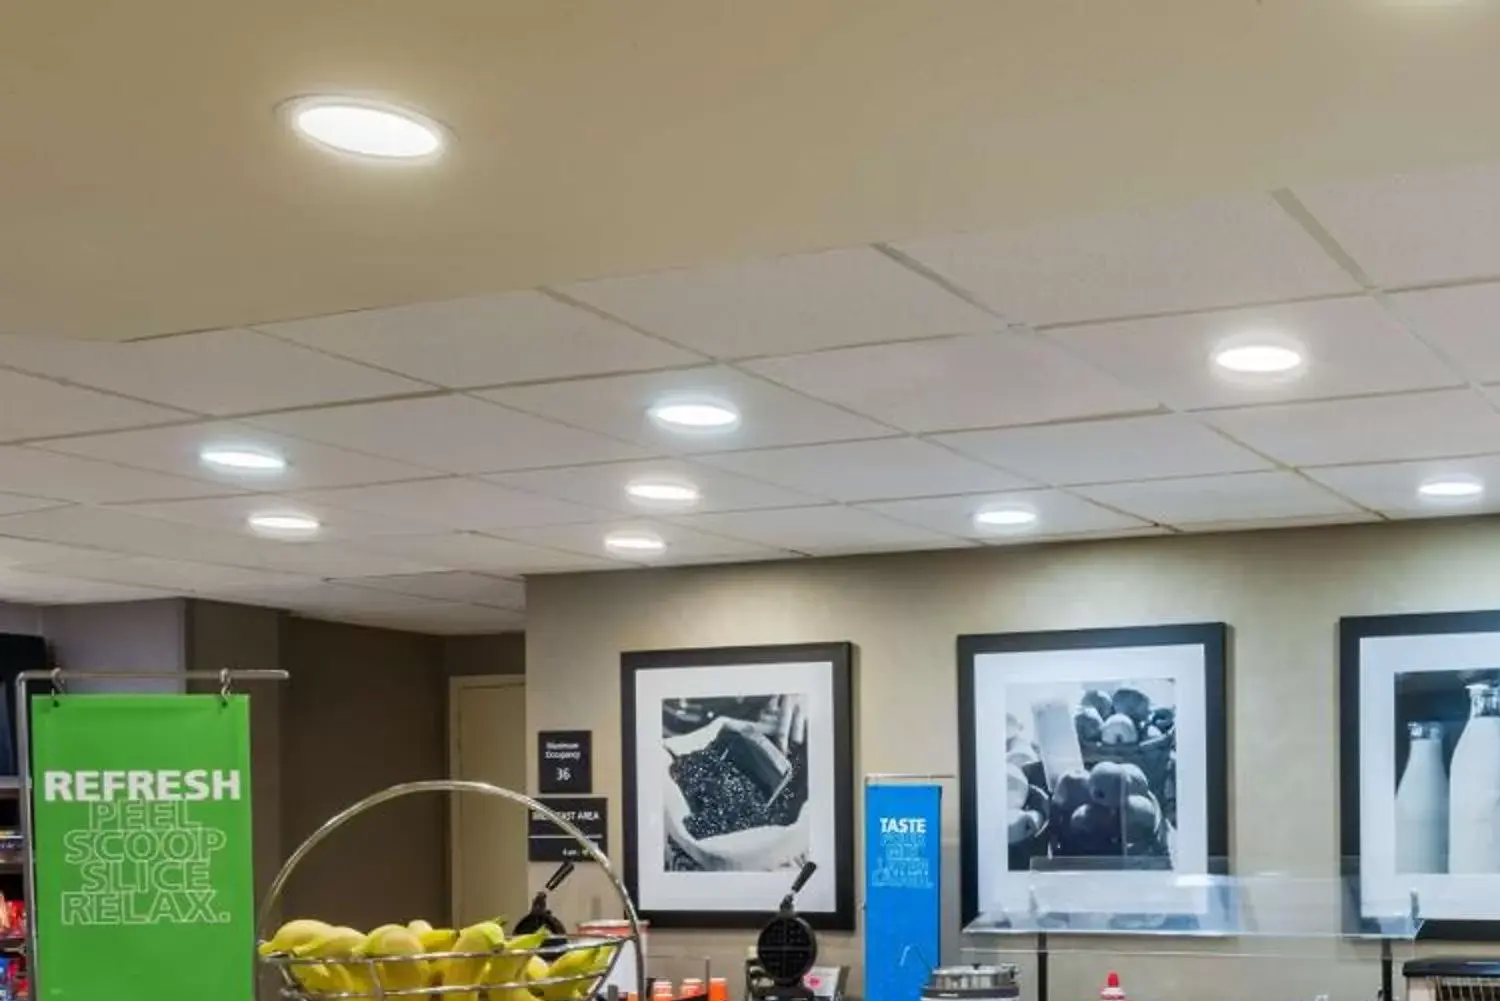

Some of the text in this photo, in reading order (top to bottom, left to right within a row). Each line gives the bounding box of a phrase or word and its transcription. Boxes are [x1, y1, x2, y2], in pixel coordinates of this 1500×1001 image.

[44, 769, 241, 801] REFRESH
[90, 799, 201, 831] PEEL
[880, 817, 927, 833] TASTE
[63, 827, 227, 864] SCOOP
[80, 859, 213, 894] SLICE
[61, 889, 231, 925] RELAX.
